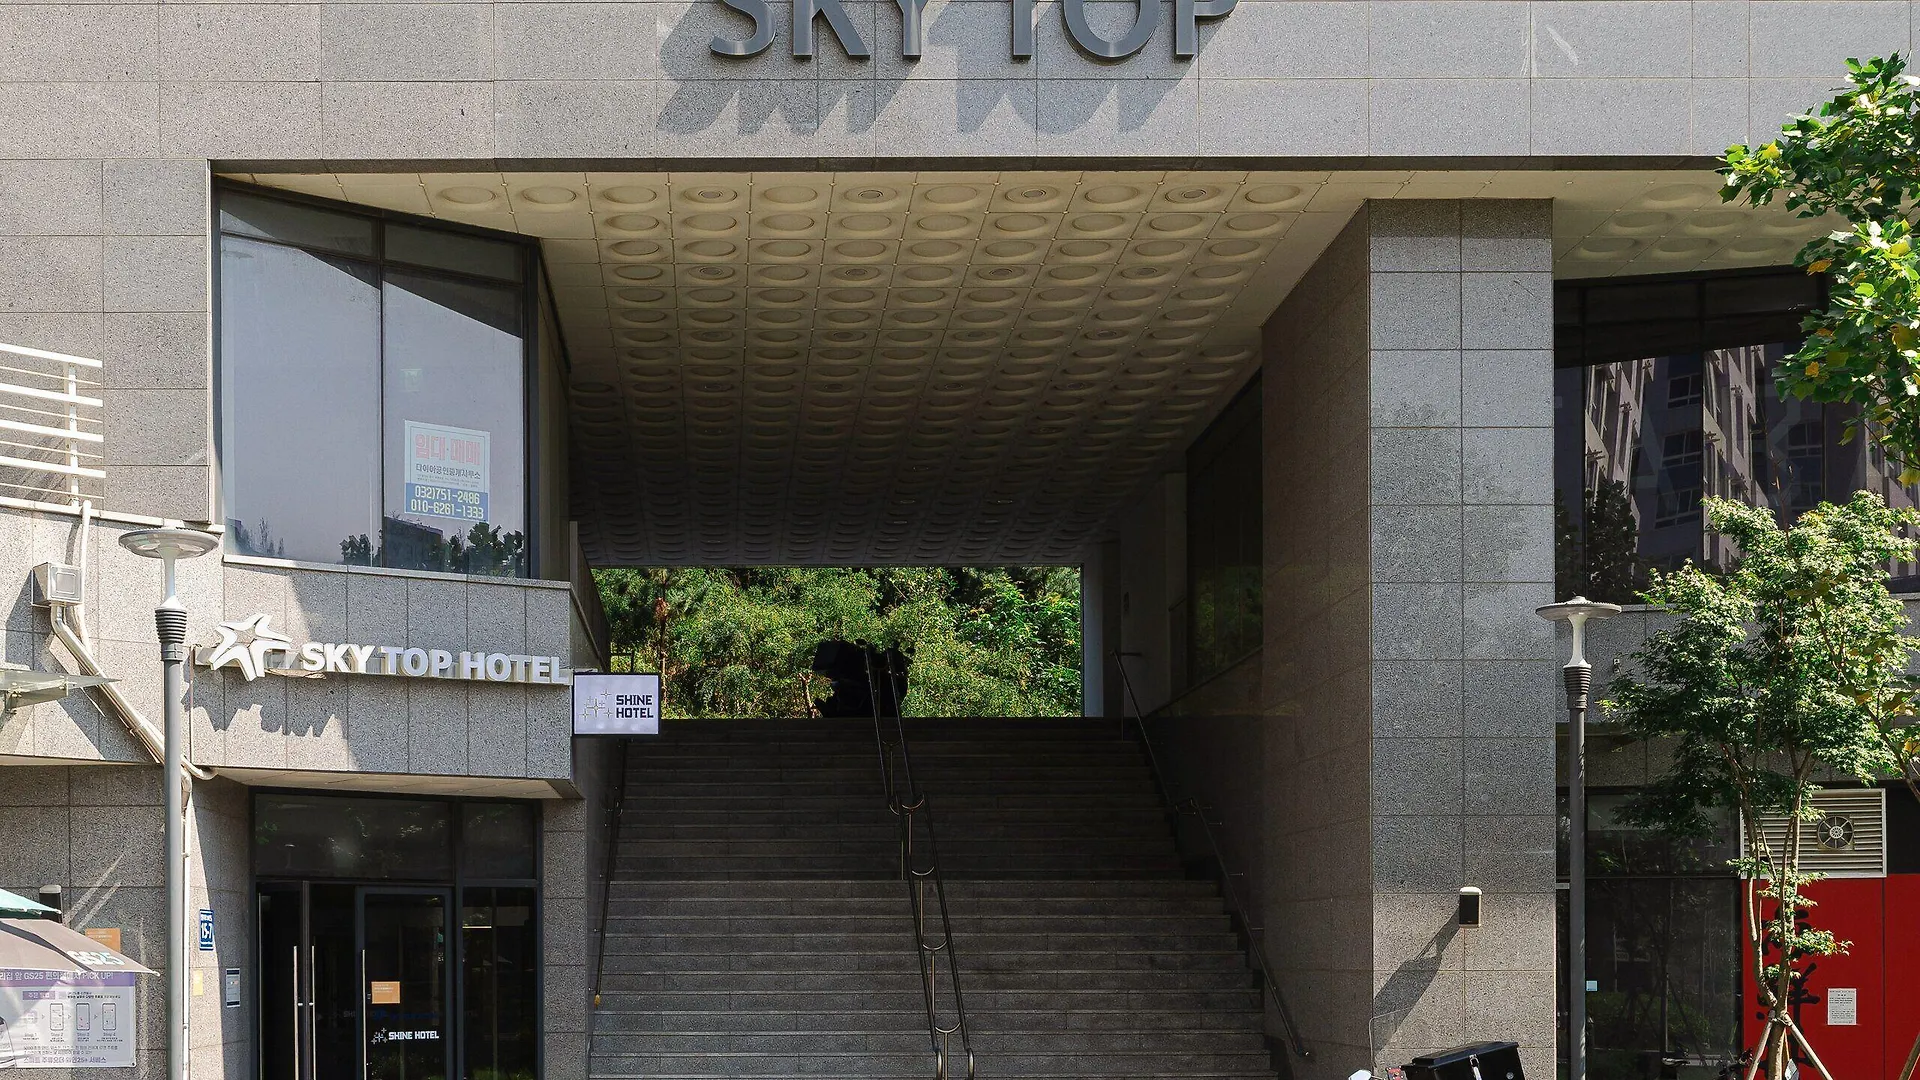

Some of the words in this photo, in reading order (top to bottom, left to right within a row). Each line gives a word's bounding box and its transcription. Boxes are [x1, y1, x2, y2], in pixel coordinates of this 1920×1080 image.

[414, 485, 480, 505] 032)751-2486
[410, 498, 484, 519] 010-6261-1333
[301, 641, 375, 674] SKY
[380, 645, 453, 678] TOP
[459, 651, 569, 684] HOTEL
[616, 694, 652, 705] SHINE
[616, 707, 654, 718] HOTEL
[66, 950, 125, 966] GS25
[23, 972, 44, 980] GS25
[388, 1031, 413, 1041] SHINE
[414, 1030, 440, 1040] HOTEL
